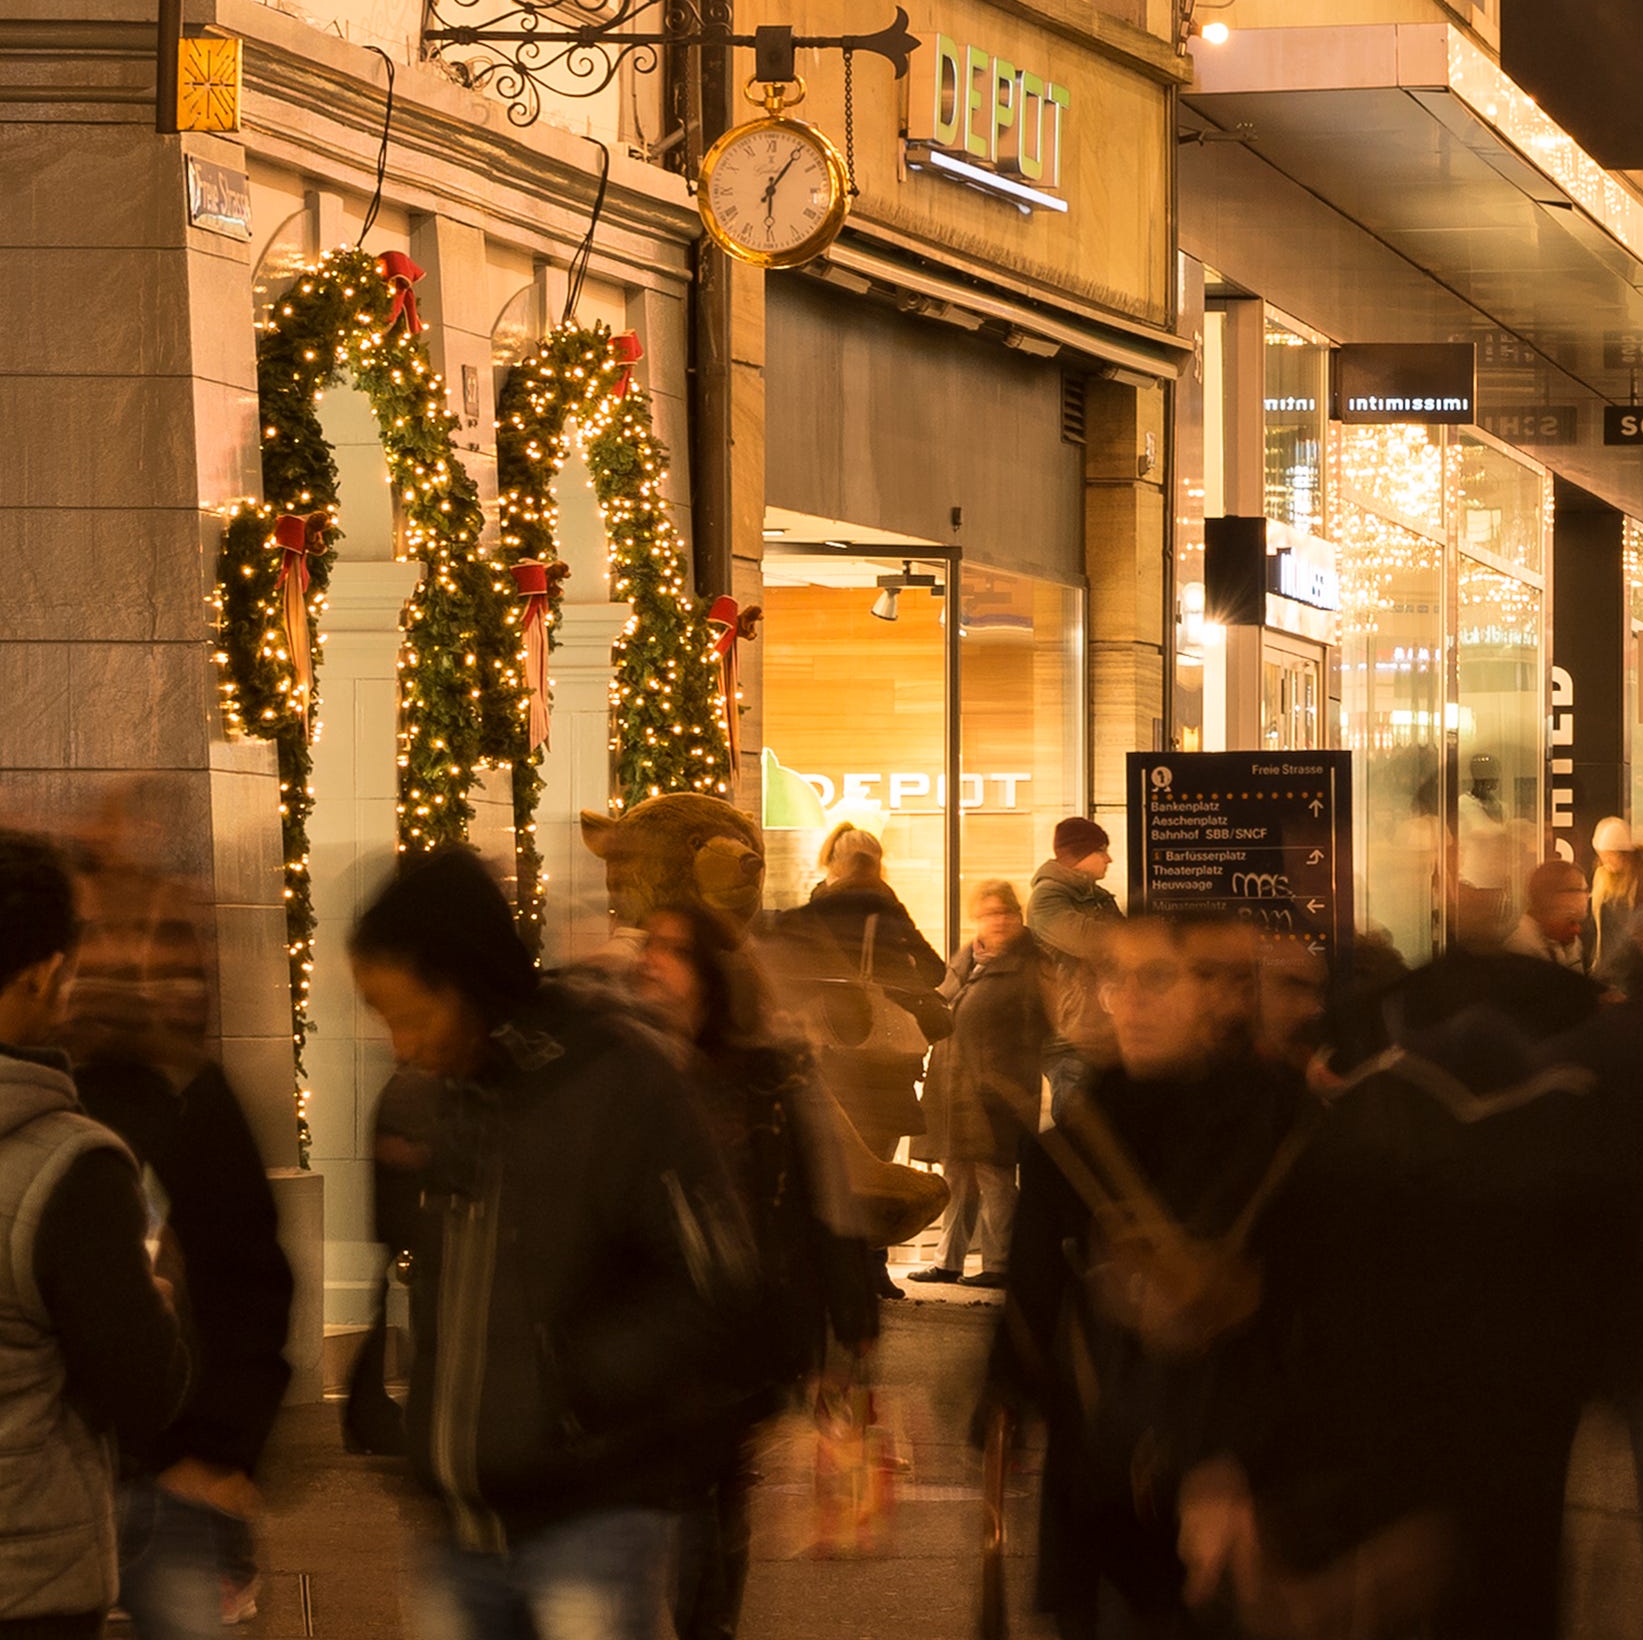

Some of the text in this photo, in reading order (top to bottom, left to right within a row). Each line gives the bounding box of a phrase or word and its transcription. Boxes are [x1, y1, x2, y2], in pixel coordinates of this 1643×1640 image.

[922, 34, 1071, 188] DEPOT
[1348, 396, 1469, 412] intimissimi
[1252, 764, 1324, 776] Freie Strasse
[1151, 801, 1220, 813] Bankenplatz
[1152, 815, 1228, 827] Aeschenplatz
[1151, 828, 1268, 841] Bahnhof SBB/SNCF
[1165, 850, 1247, 863] Barfüsserplatz
[1153, 865, 1224, 877] Theaterplatz
[1152, 880, 1213, 891] Heuwaage
